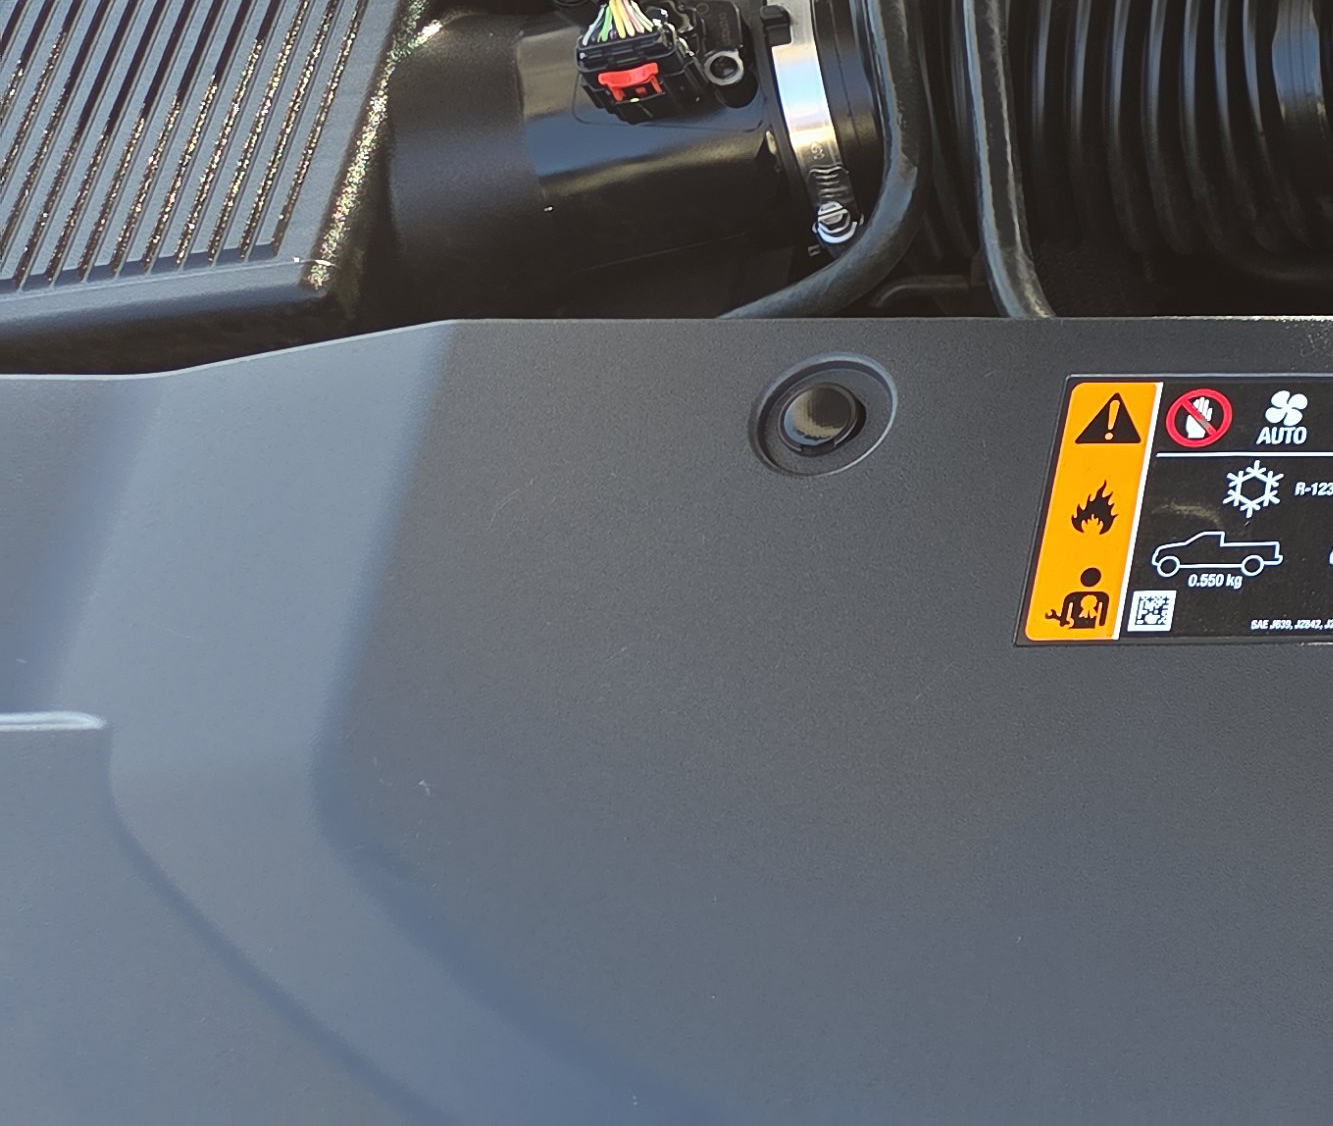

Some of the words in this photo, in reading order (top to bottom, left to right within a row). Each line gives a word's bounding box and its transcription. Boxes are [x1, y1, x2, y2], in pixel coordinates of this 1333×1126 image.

[1256, 427, 1307, 444] AUTO
[1188, 574, 1224, 587] 0.550
[1226, 574, 1243, 589] kg
[1251, 620, 1269, 630] SAE
